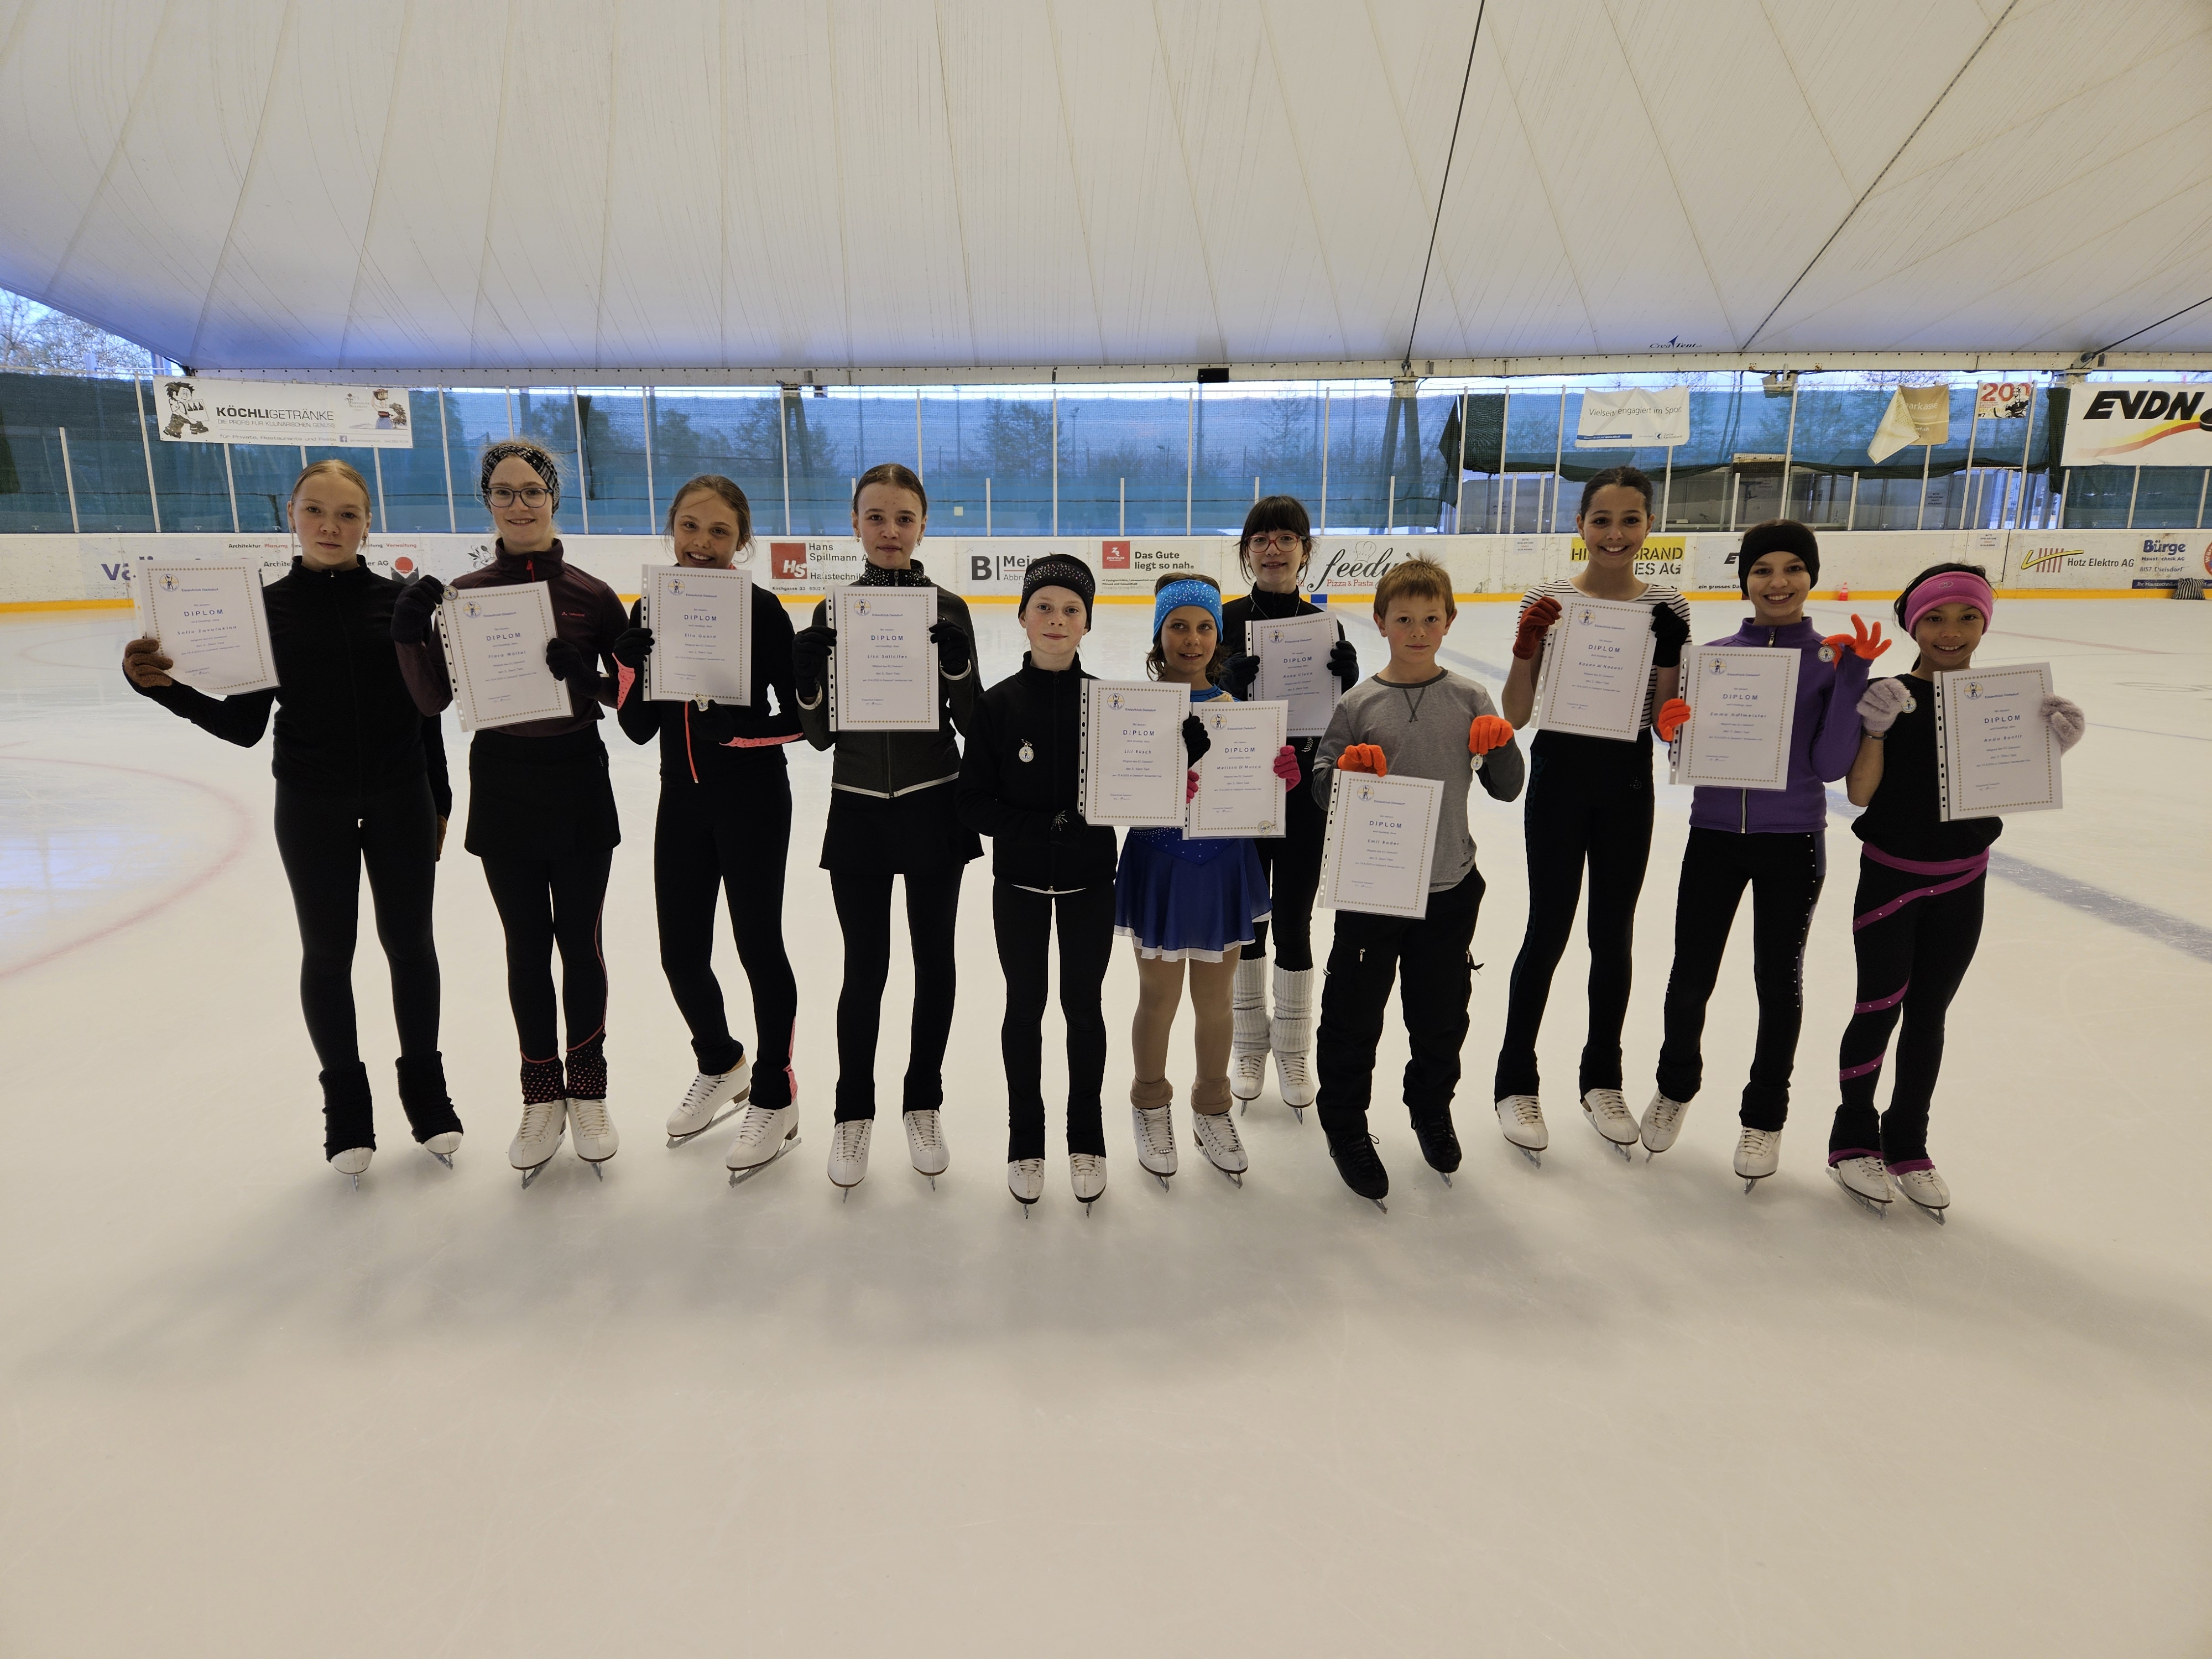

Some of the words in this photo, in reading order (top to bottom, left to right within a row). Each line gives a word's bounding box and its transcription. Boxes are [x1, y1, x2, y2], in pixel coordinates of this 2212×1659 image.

[1618, 407, 1651, 415] engagiert
[2143, 540, 2186, 555] Bürge
[810, 553, 857, 562] Spillmann
[2067, 557, 2086, 566] Hotz
[2089, 558, 2119, 567] Elektro
[2121, 559, 2134, 567] AG
[783, 560, 807, 577] HS
[972, 556, 992, 580] B
[1135, 562, 1156, 571] liegt
[1659, 563, 1681, 575] AG
[811, 572, 861, 581] Haustechni
[486, 632, 521, 641] DIPLOM
[1588, 644, 1620, 653] DIPLOM
[1984, 715, 2020, 723] DIPLOM
